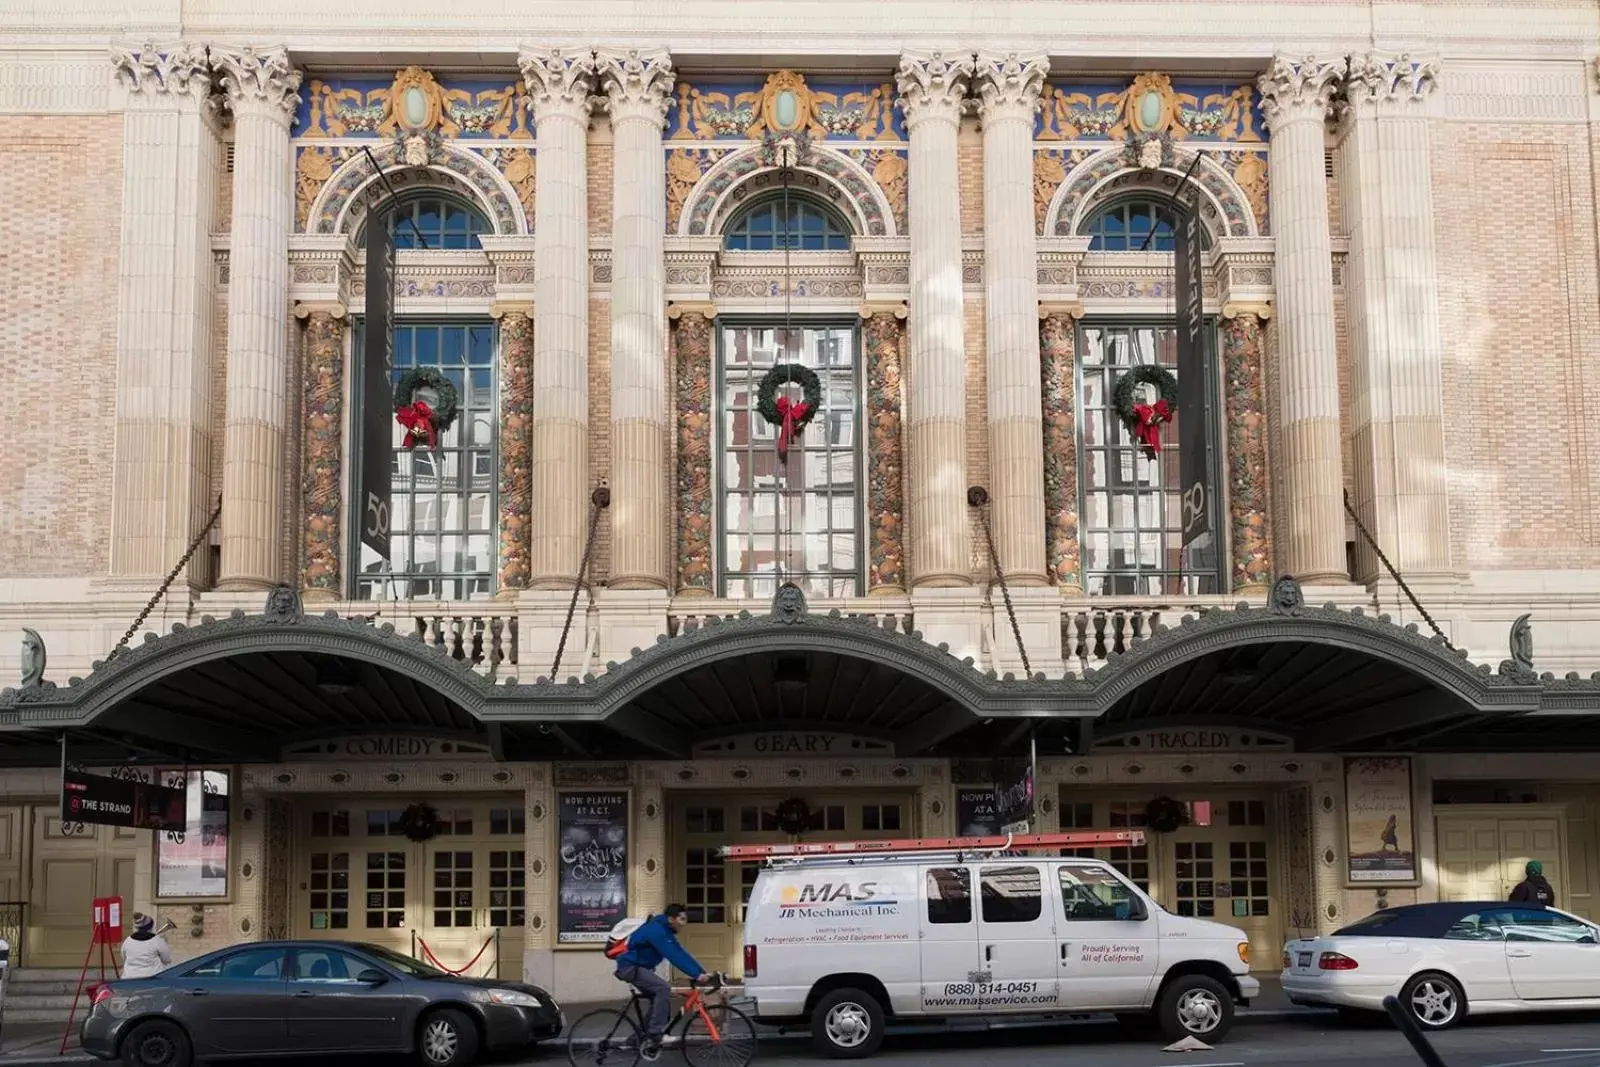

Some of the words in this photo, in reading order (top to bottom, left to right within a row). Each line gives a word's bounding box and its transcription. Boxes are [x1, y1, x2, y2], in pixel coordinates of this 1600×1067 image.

[367, 491, 389, 537] 50
[1183, 482, 1204, 533] 50
[753, 734, 836, 752] GEARY
[1146, 731, 1233, 748] TRAGEDY
[345, 738, 435, 755] COMEDY
[565, 797, 584, 805] NOW
[586, 796, 622, 805] PLAYING
[961, 793, 984, 801] NOW
[82, 799, 98, 811] THE
[100, 802, 131, 814] STRAND
[974, 806, 984, 814] AT
[799, 882, 877, 902] MAS
[779, 909, 796, 919] JB
[798, 906, 873, 919] Mechanical
[877, 906, 900, 915] Inc.
[850, 933, 882, 942] Equipment
[1081, 944, 1110, 953] Proudly
[1112, 944, 1140, 954] Serving
[1081, 954, 1092, 962] All
[1093, 954, 1102, 962] of
[944, 983, 976, 996] (888)
[978, 982, 1038, 994] 314-0451
[924, 994, 1058, 1007] www.masservice.com
